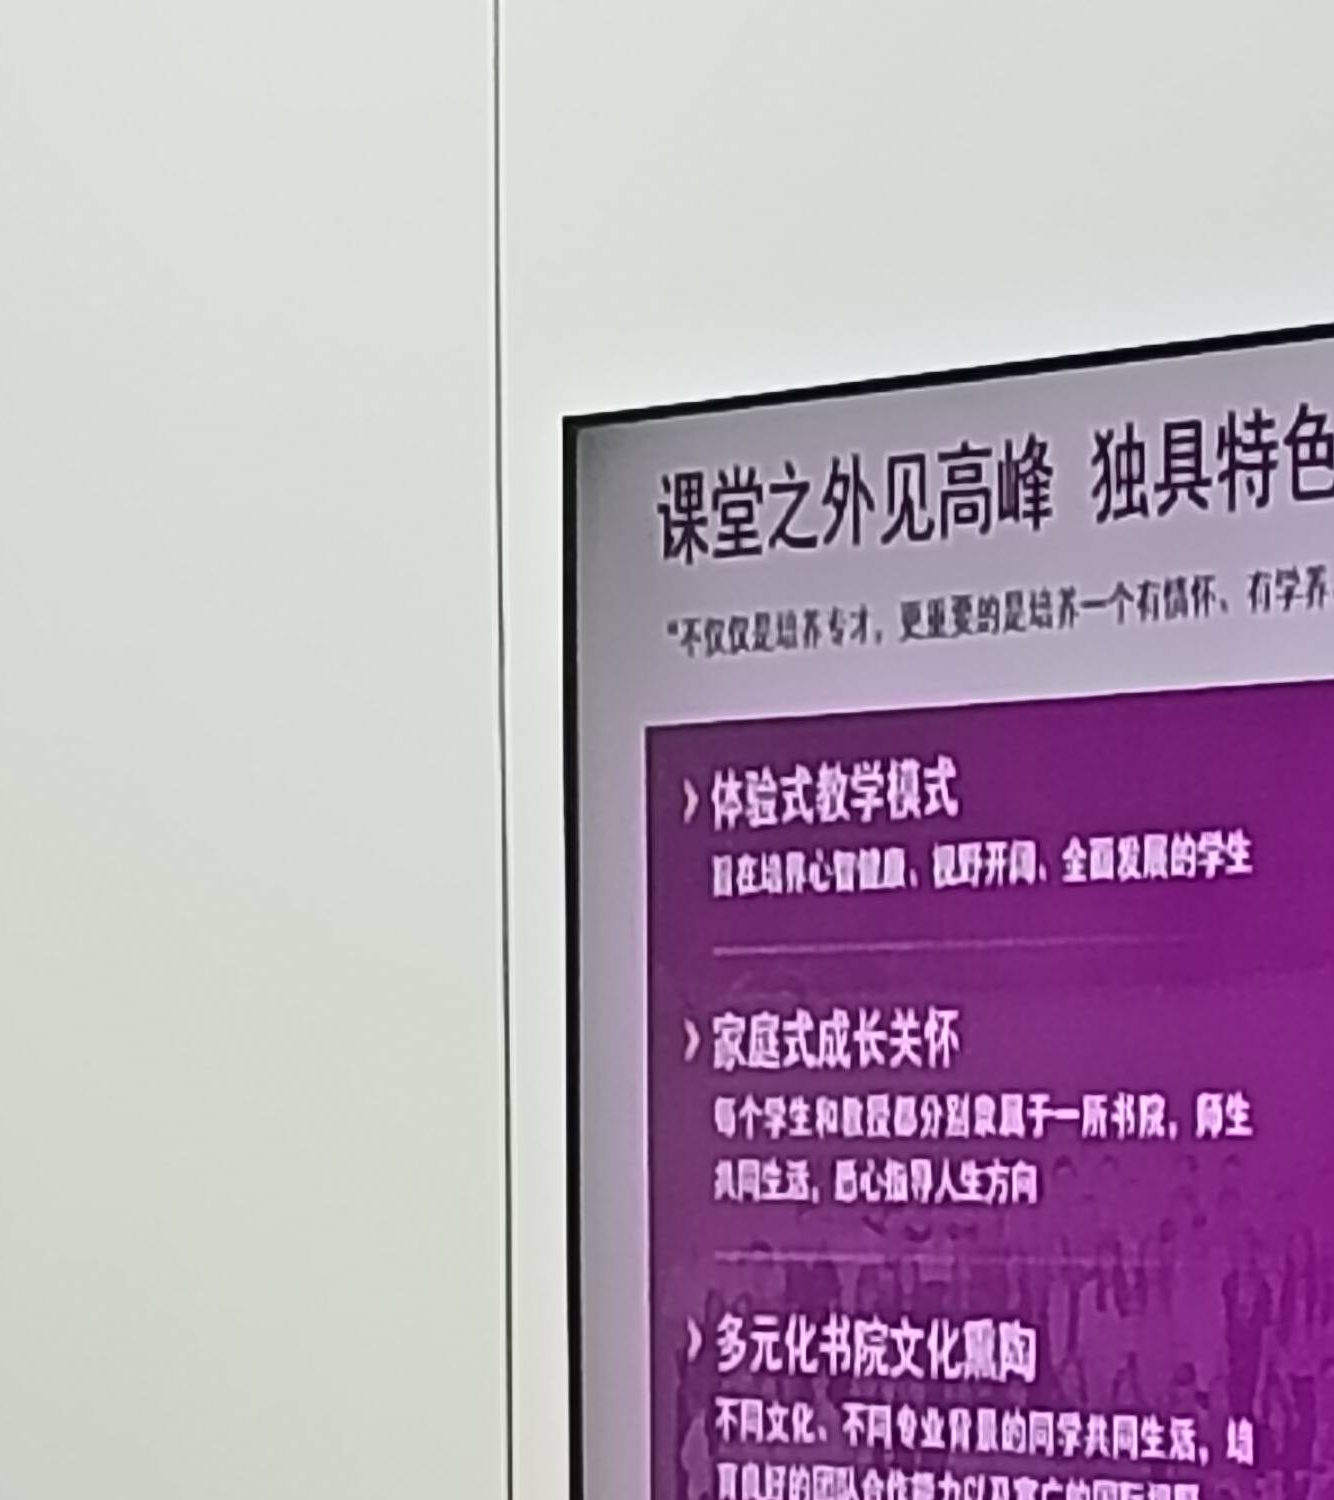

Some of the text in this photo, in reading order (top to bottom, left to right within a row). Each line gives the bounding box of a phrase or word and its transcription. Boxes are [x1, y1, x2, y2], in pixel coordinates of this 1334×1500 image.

[657, 431, 1054, 565] 课堂之外见高峰
[711, 755, 959, 832] 体验式教学模式
[712, 1007, 960, 1071] 家庭式成长关怀
[716, 1311, 1037, 1383] 多元化书院文化熏陶
